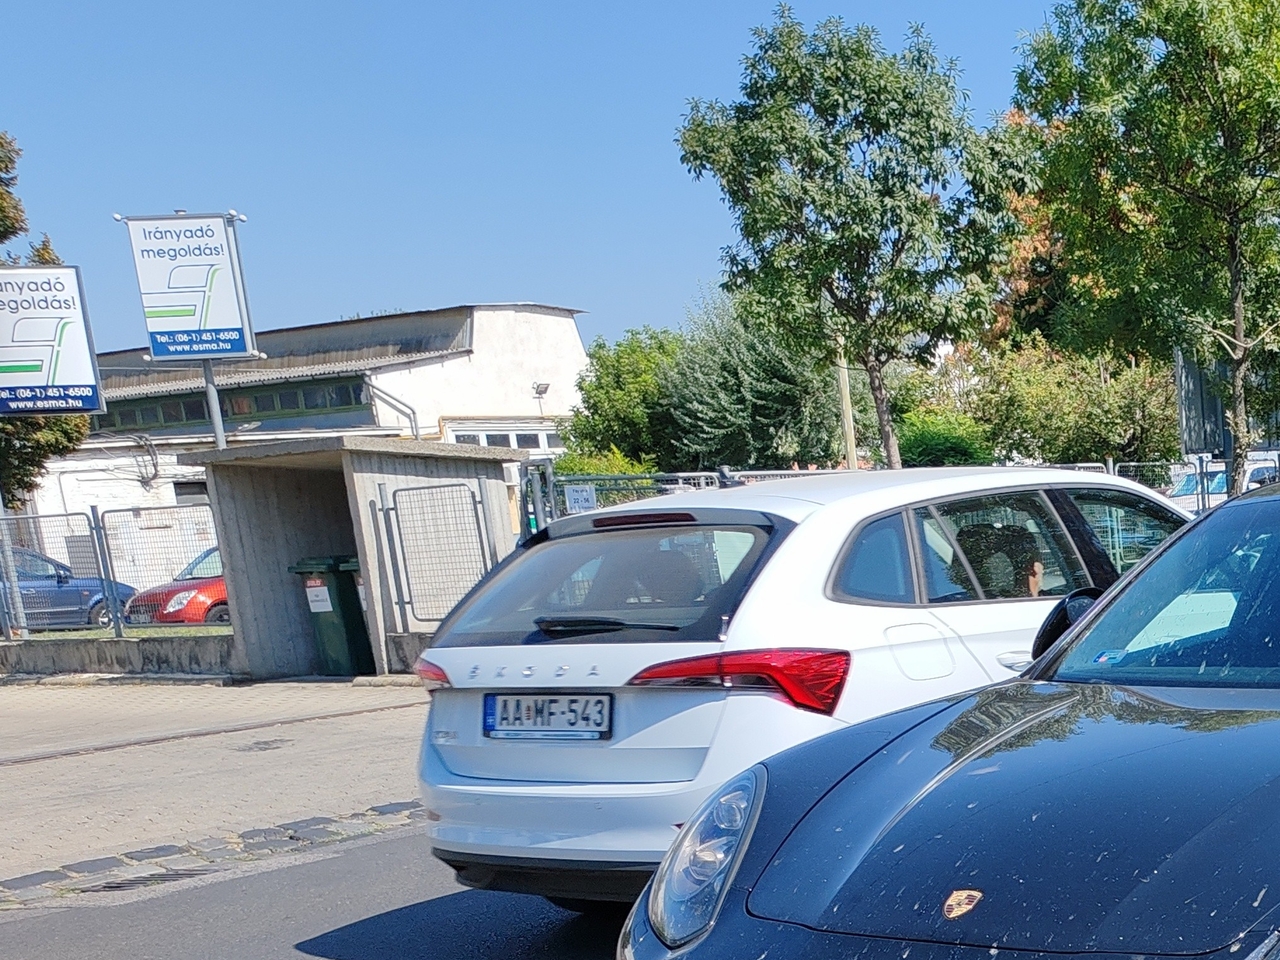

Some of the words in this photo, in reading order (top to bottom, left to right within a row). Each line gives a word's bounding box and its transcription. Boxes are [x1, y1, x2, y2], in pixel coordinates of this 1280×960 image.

[142, 224, 215, 242] Irányadó
[140, 243, 225, 261] megoldás!
[155, 334, 174, 343] Tel.:
[175, 333, 200, 343] (06-1)
[201, 331, 240, 341] 451-6500
[168, 342, 232, 352] www.esma.hu
[16, 388, 45, 399] (06-1)
[46, 387, 93, 397] 451-6500
[8, 398, 83, 409] www.esma.hu
